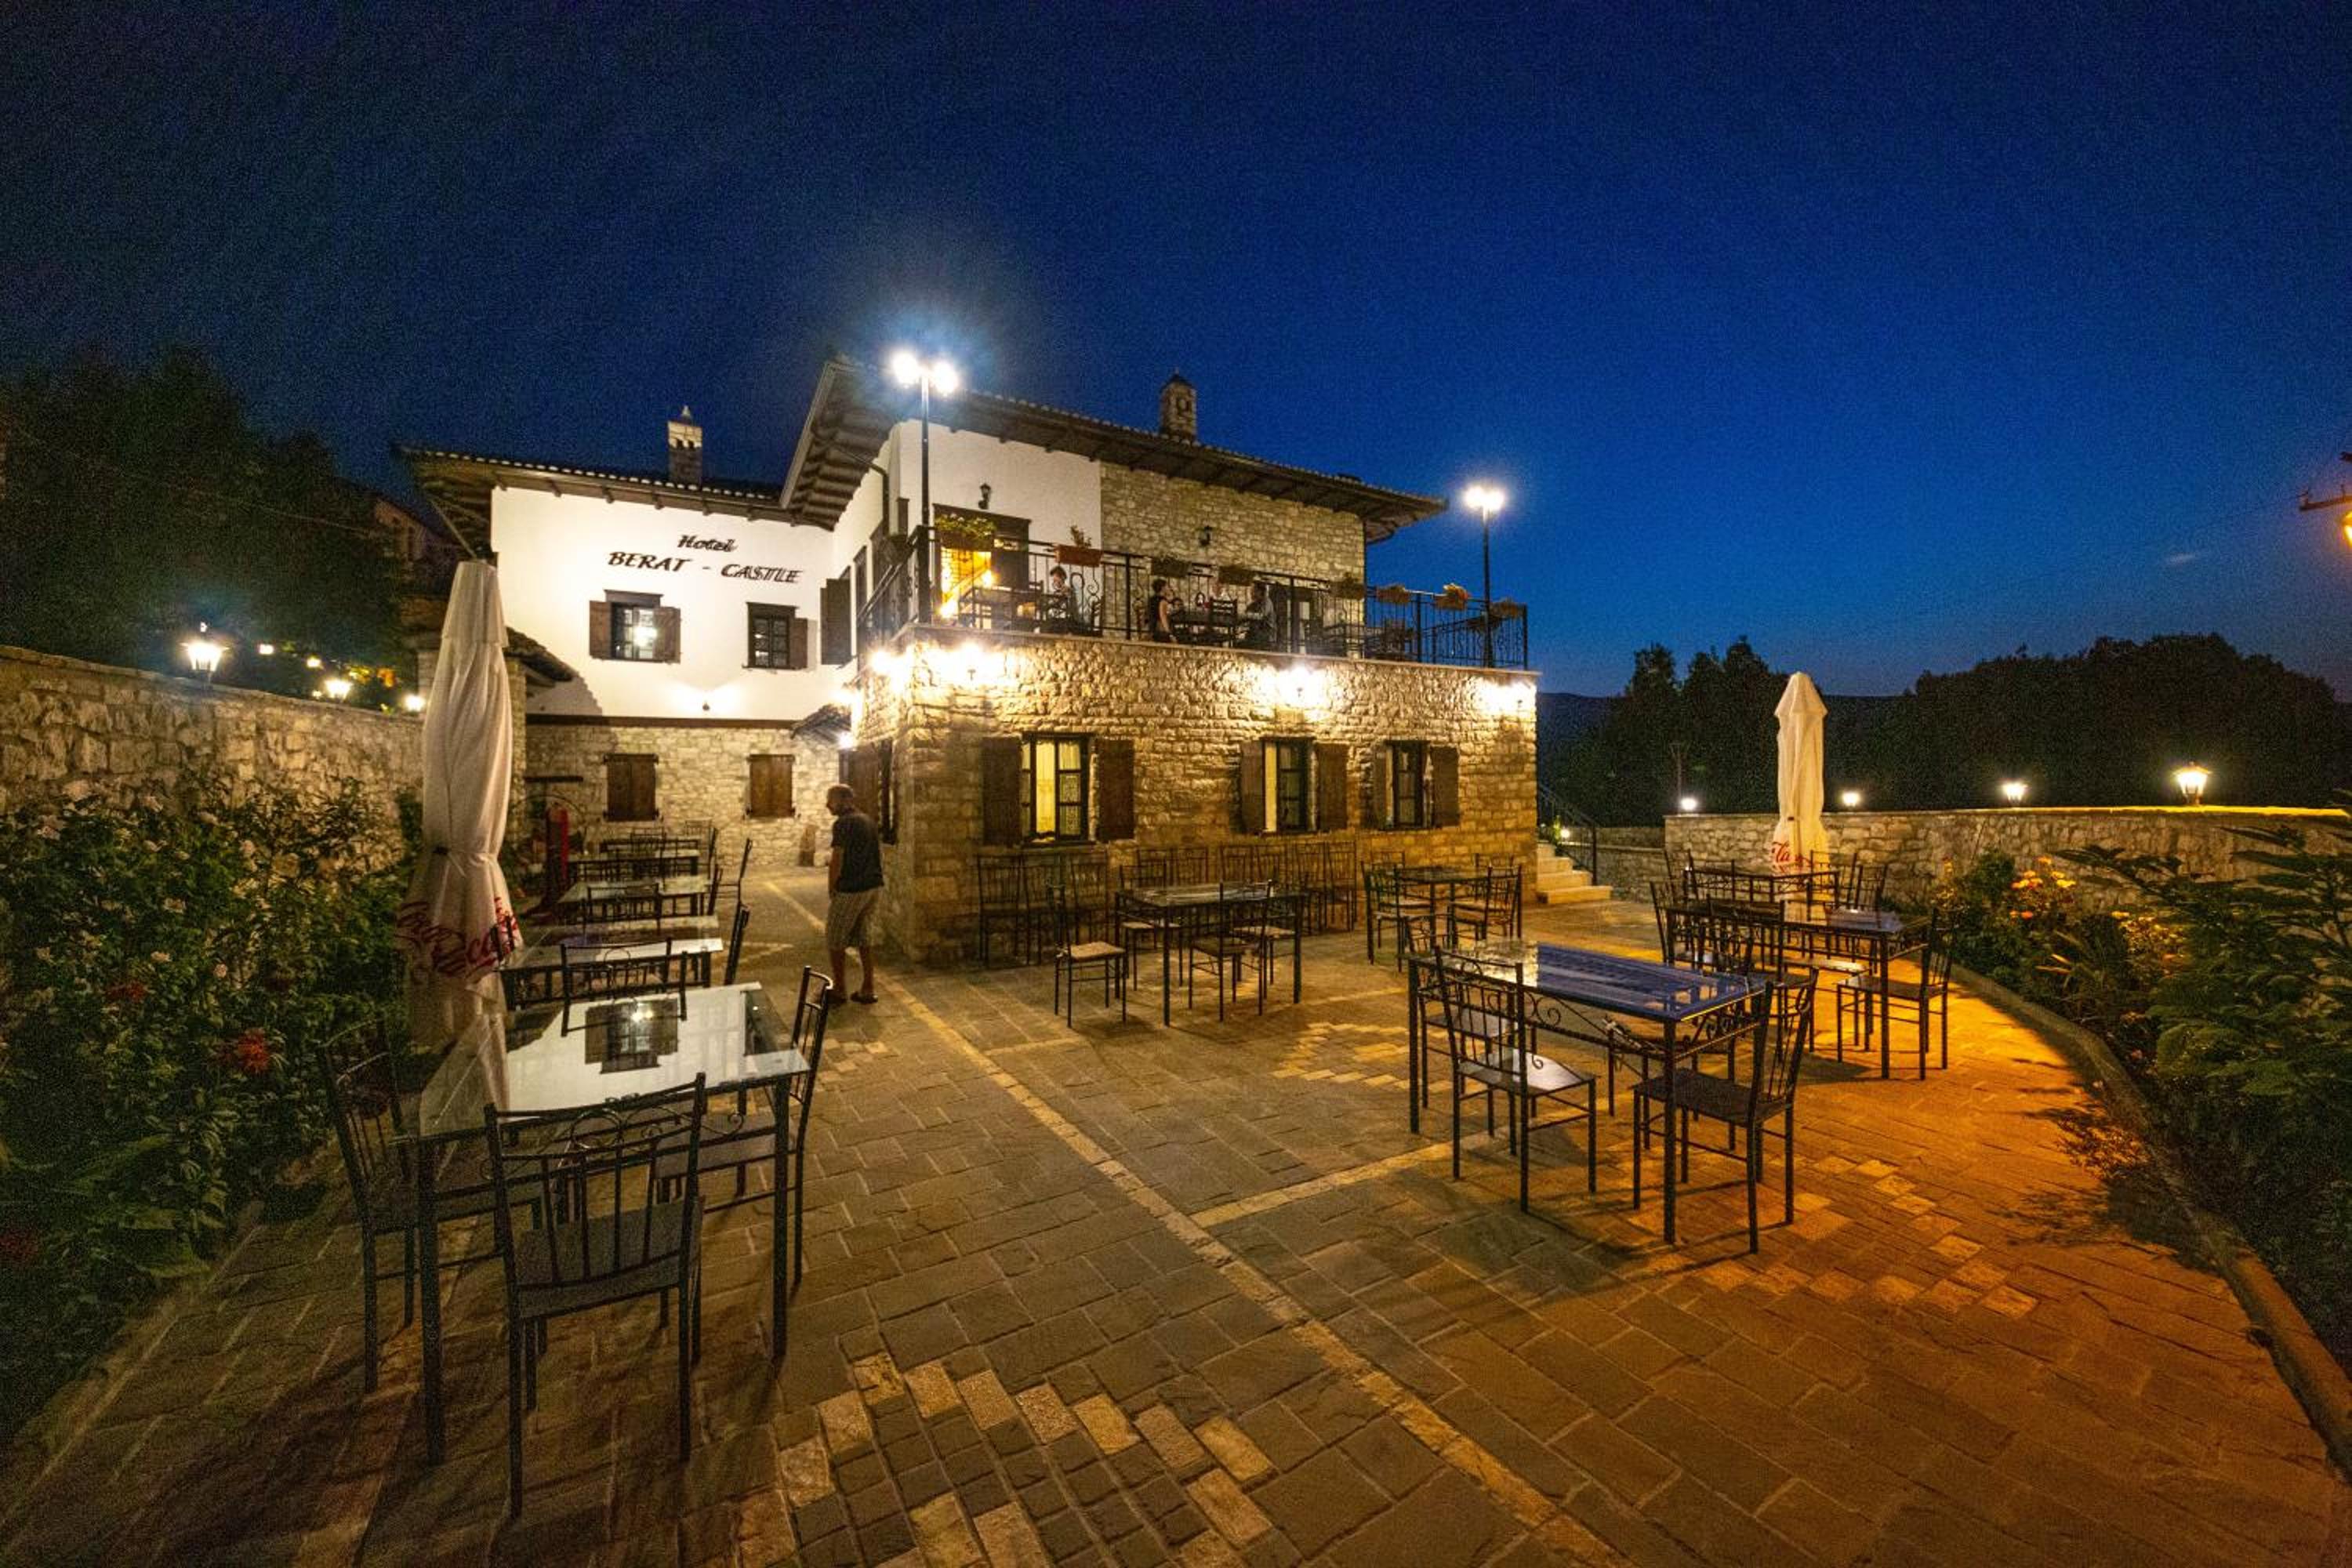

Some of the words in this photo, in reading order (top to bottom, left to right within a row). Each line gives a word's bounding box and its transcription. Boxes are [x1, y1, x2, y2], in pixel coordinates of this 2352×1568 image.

[677, 535, 739, 552] Hotel
[607, 551, 691, 572] BERAT
[720, 563, 804, 583] CASTLE
